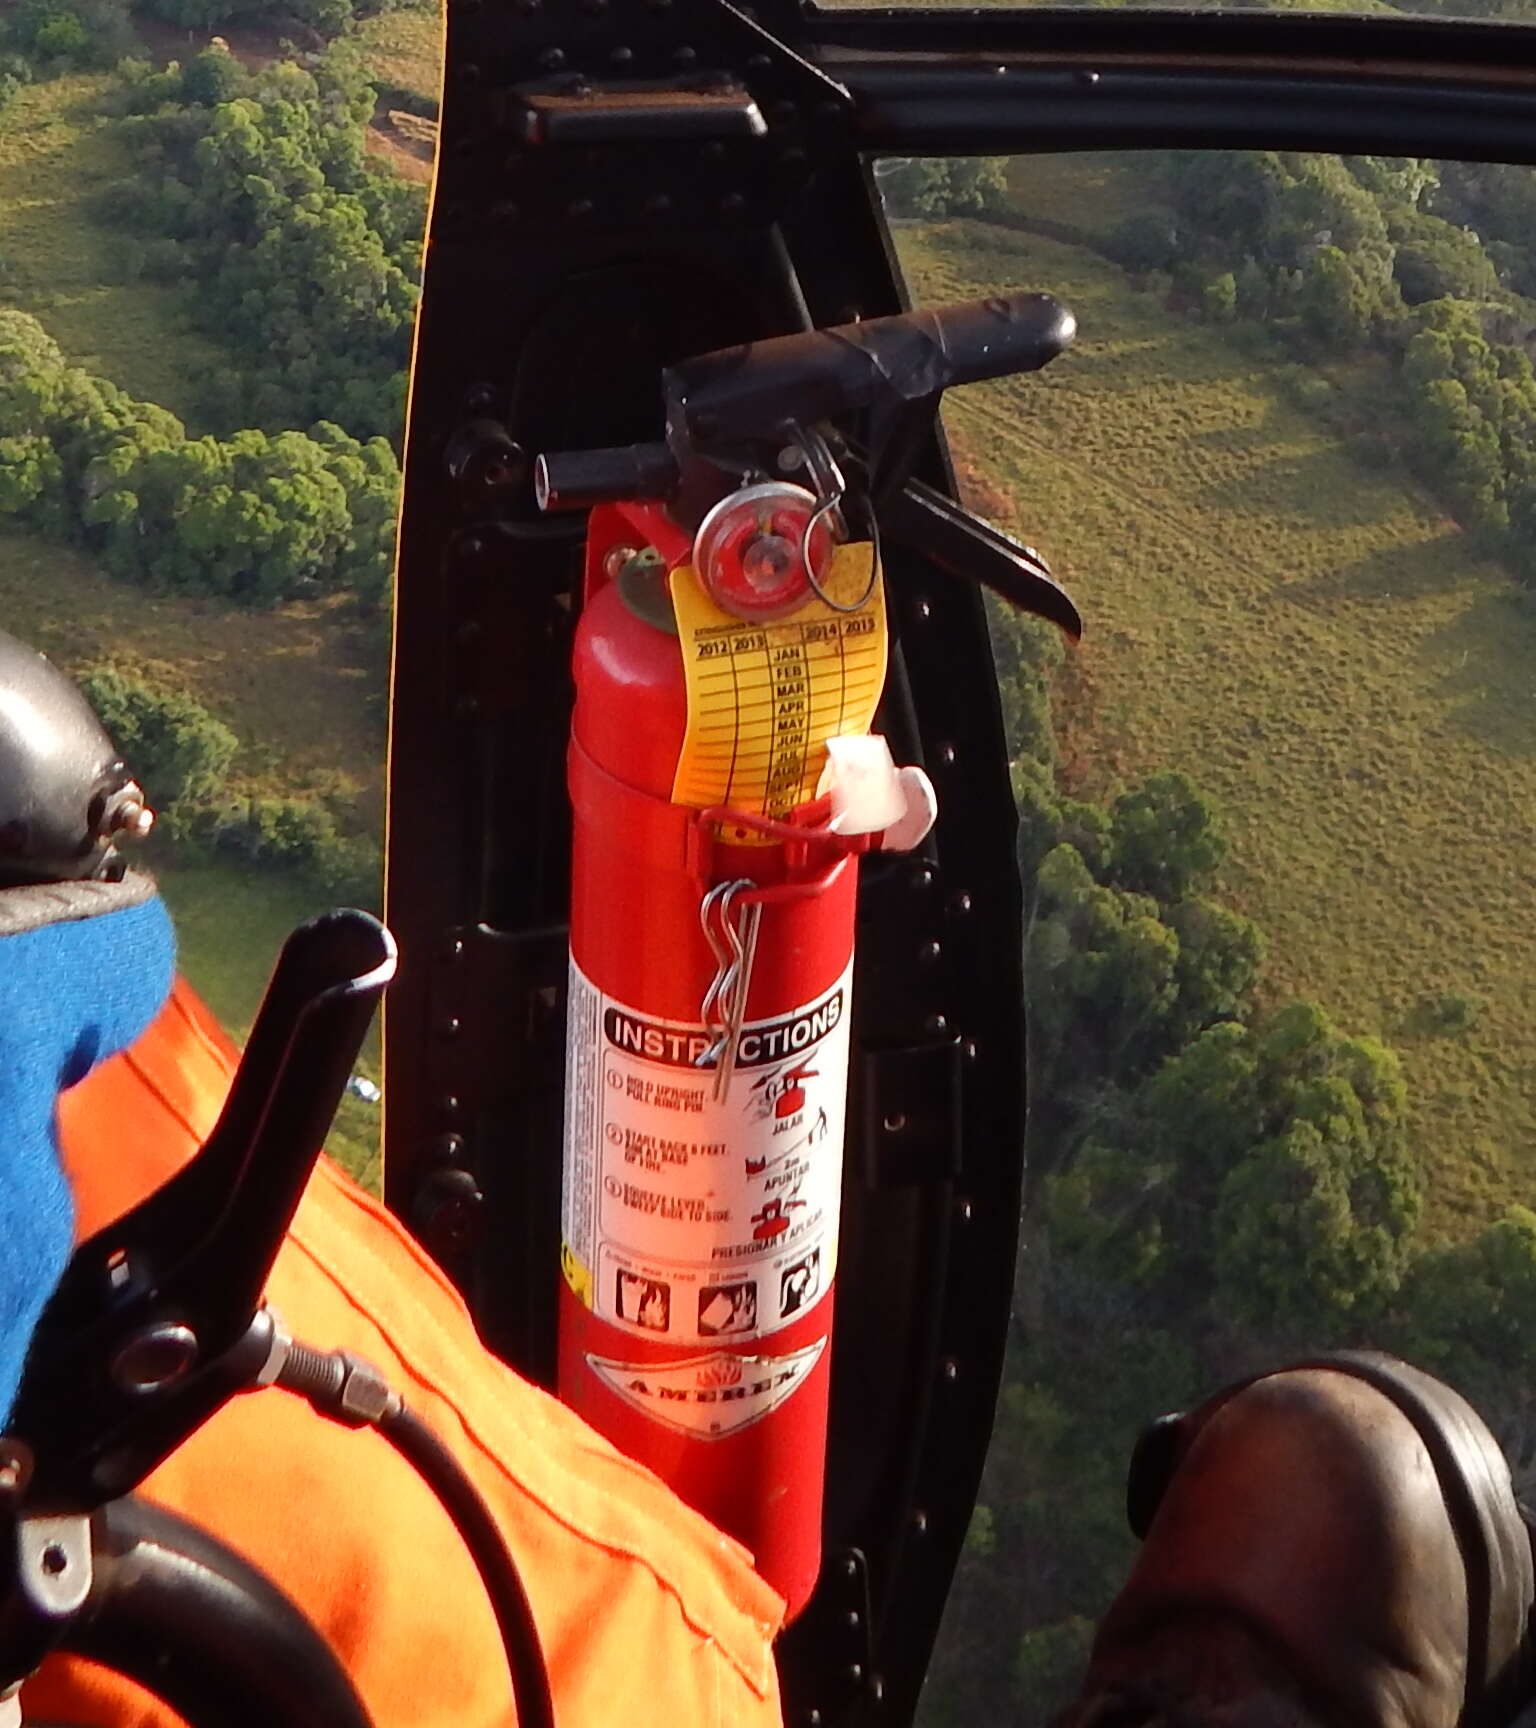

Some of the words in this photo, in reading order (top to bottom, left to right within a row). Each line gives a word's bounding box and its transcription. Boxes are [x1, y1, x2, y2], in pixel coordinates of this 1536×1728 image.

[698, 639, 728, 656] 2012
[805, 624, 837, 641] 2014
[774, 648, 800, 661] JAN
[776, 665, 802, 679] FEB
[777, 683, 804, 696] MAR
[779, 701, 804, 714] APR
[778, 718, 804, 731] MAY
[777, 734, 804, 747] JUN
[614, 996, 842, 1064] INSTRCTIONS
[772, 1112, 804, 1137] JALAR
[764, 1161, 811, 1193] APUNTAR
[627, 1362, 801, 1402] AMEREX
